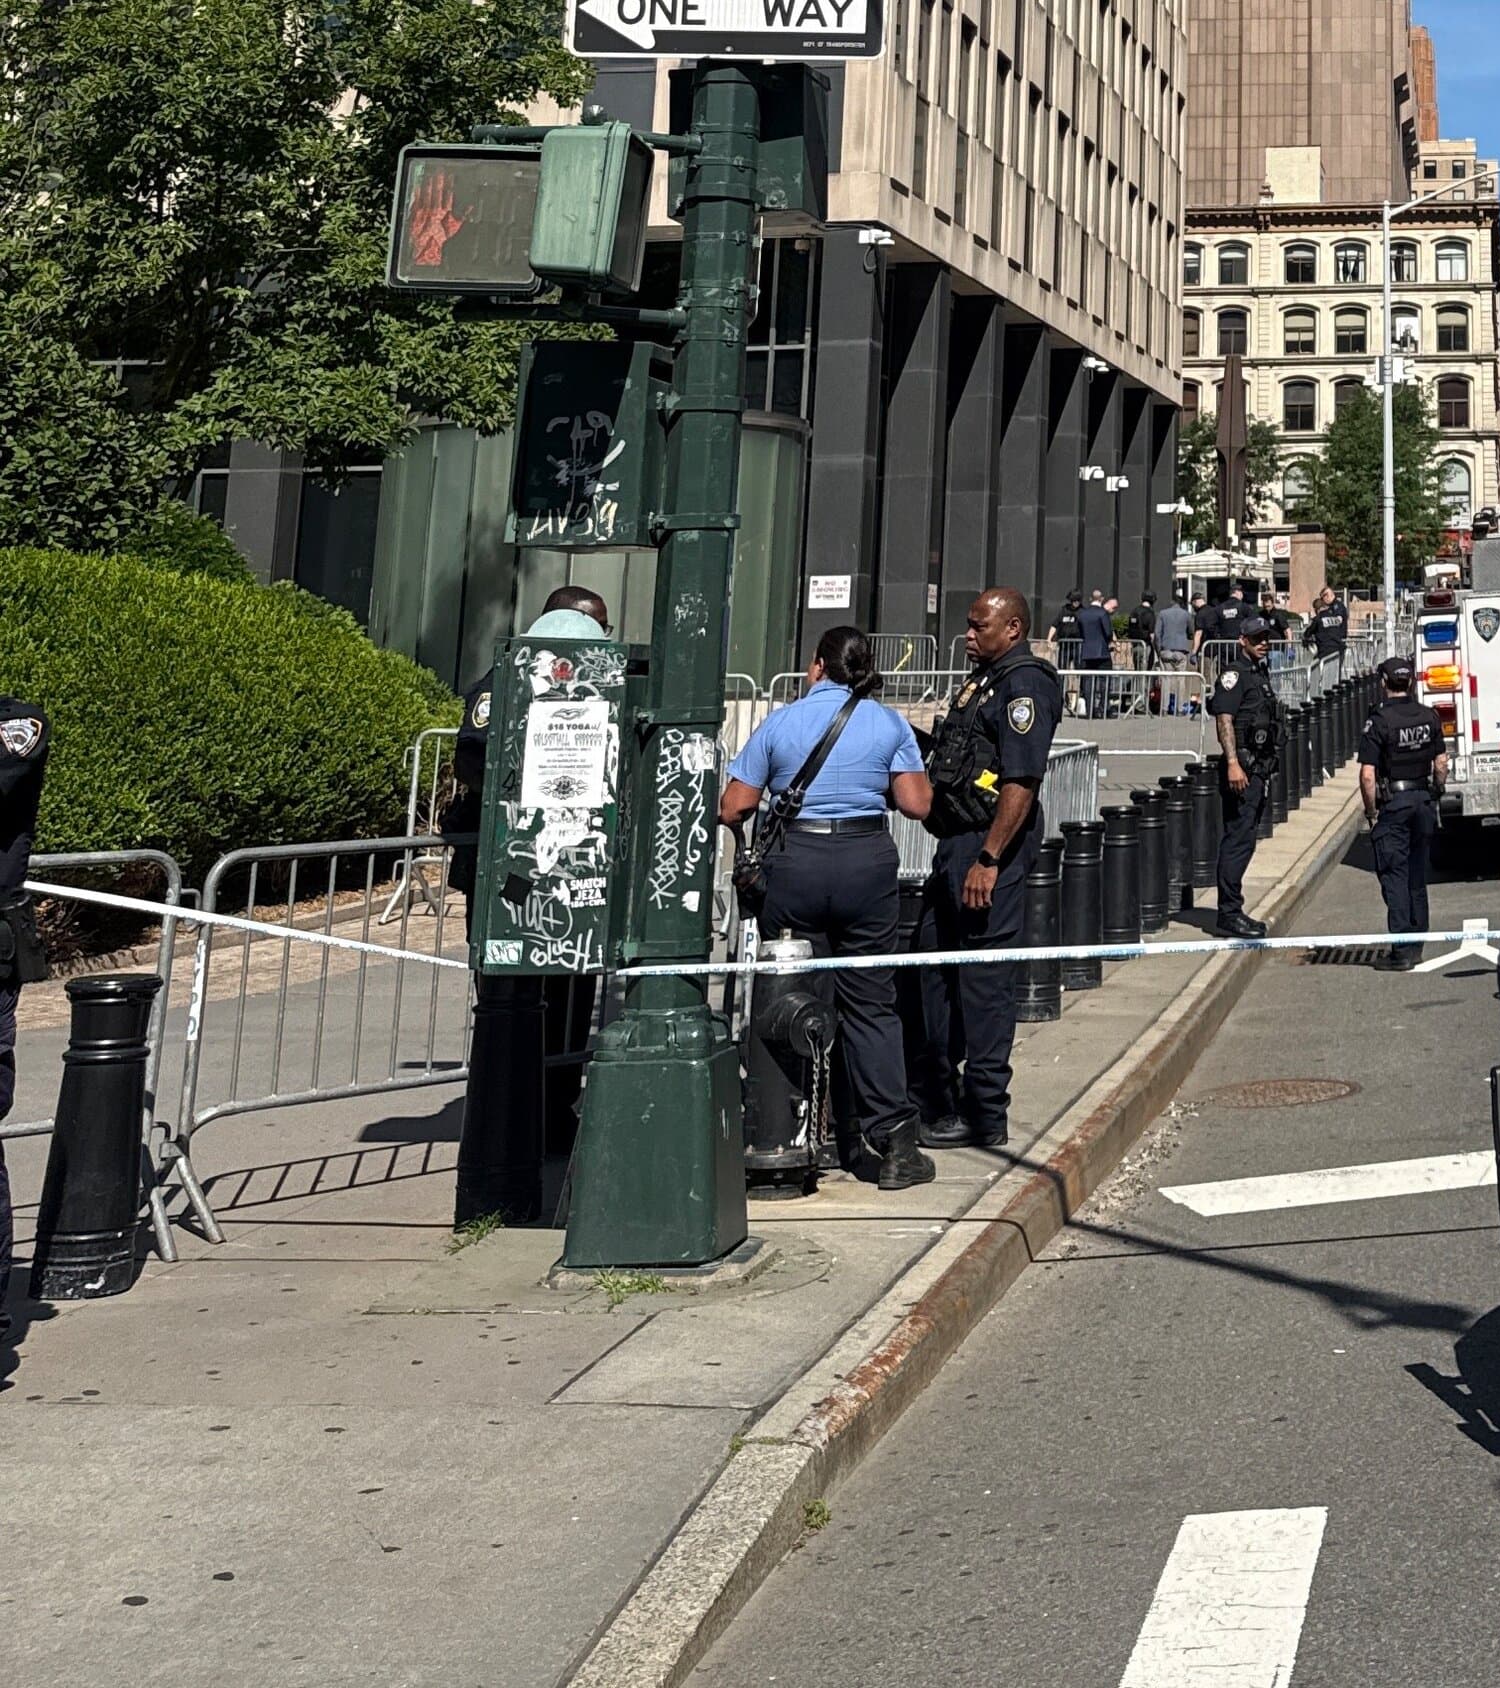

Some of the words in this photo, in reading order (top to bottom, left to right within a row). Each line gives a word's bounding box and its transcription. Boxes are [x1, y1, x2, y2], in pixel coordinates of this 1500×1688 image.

[617, 0, 706, 26] ONE
[763, 0, 852, 28] WAY
[1400, 725, 1430, 743] NYPD
[570, 877, 606, 890] SNATCH
